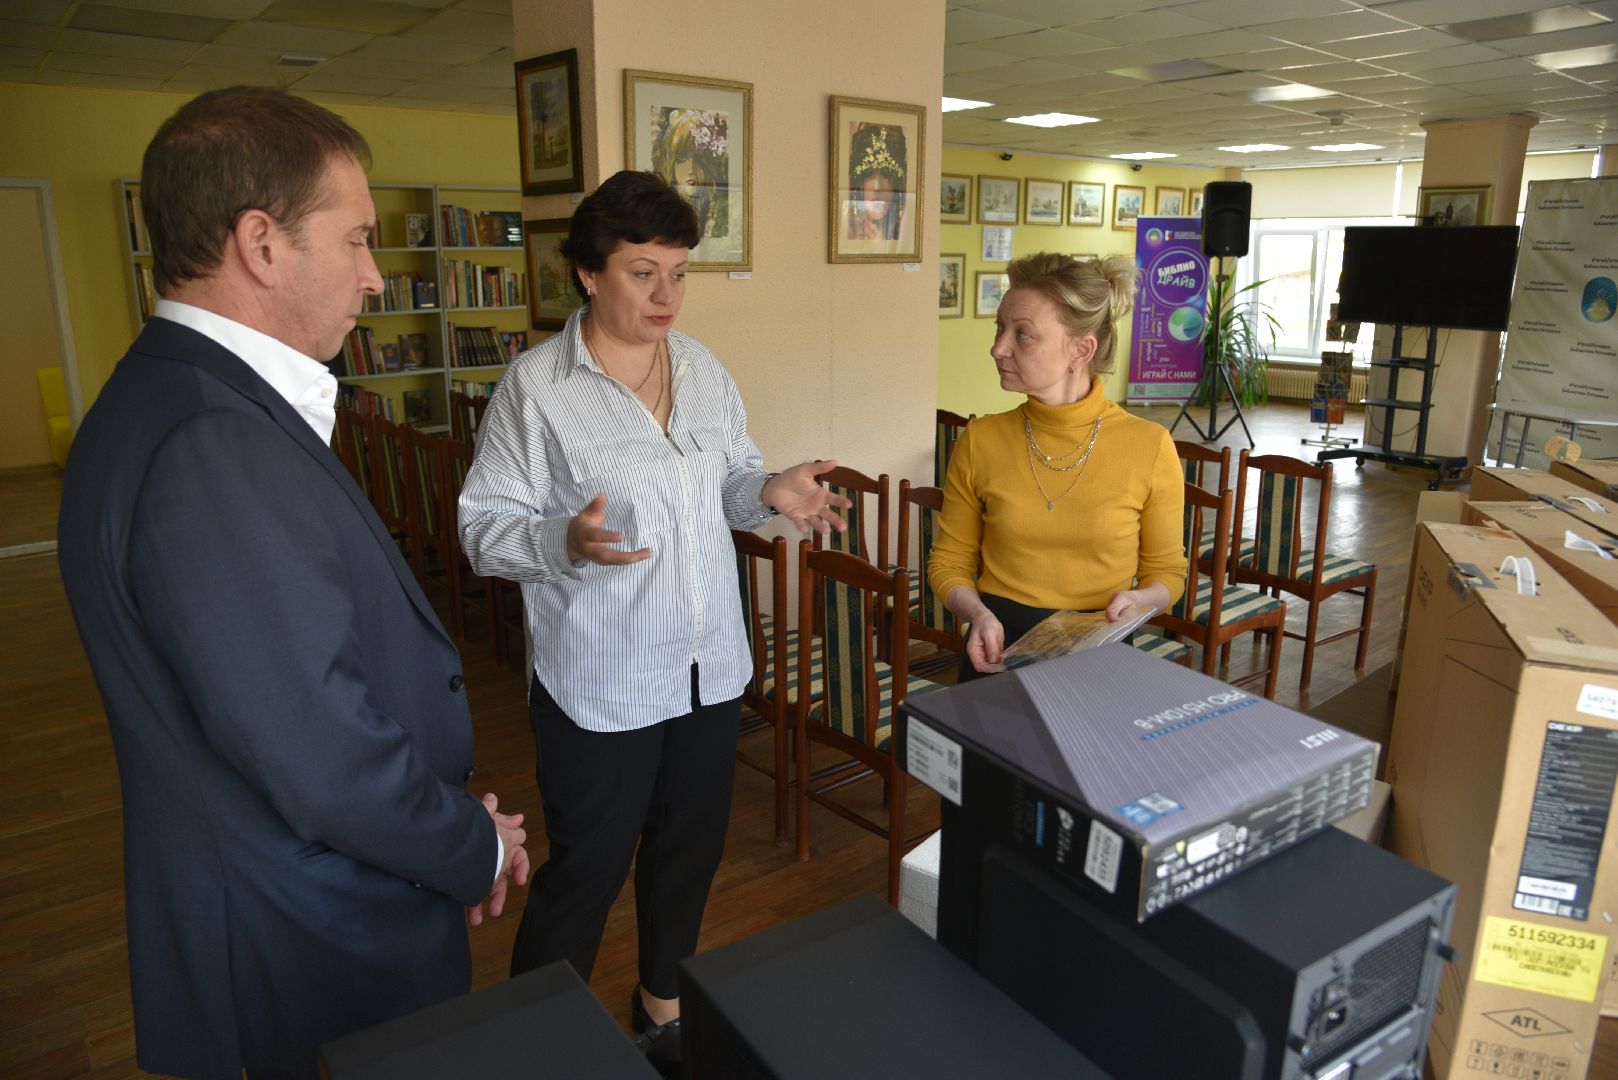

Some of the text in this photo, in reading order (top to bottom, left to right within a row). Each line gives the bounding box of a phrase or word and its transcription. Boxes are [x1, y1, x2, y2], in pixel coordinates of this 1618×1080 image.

[1157, 260, 1196, 277] БИБЛИО
[1157, 274, 1196, 289] ДРАЙВ
[1142, 368, 1167, 379] ИГРАЙ
[1174, 371, 1197, 379] НАМИ
[1208, 689, 1248, 706] PRO
[1508, 924, 1596, 951] 511592334
[1511, 1014, 1542, 1032] ATL
